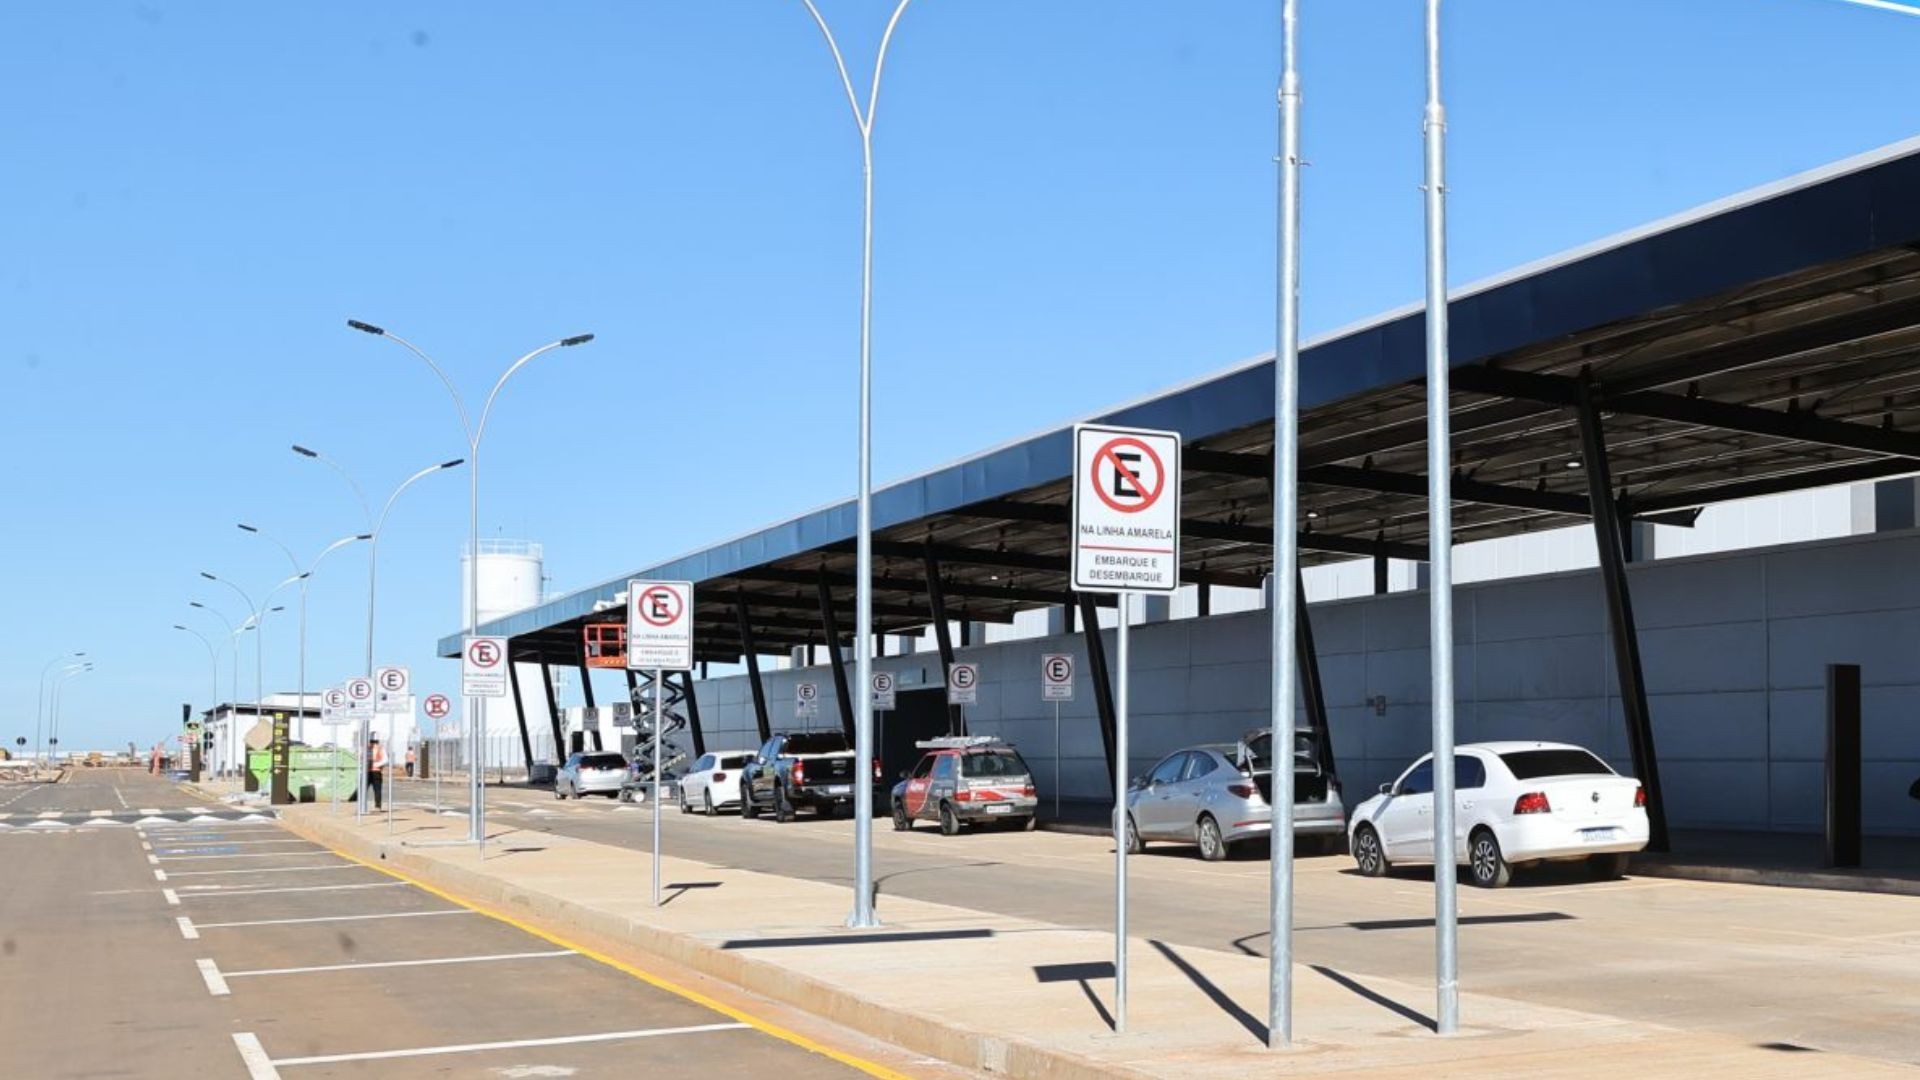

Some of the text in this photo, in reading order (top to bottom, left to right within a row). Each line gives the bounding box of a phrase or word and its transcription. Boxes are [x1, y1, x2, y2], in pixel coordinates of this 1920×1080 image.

[1114, 452, 1141, 498] E
[1081, 524, 1172, 539] NA LINHA AMARELA
[1095, 554, 1158, 568] EMBARQUE E
[1089, 569, 1163, 582] DESEMBARQUE
[652, 594, 669, 618] E
[959, 670, 968, 683] E
[1053, 662, 1063, 677] E
[387, 673, 397, 687] E
[356, 684, 364, 696] E
